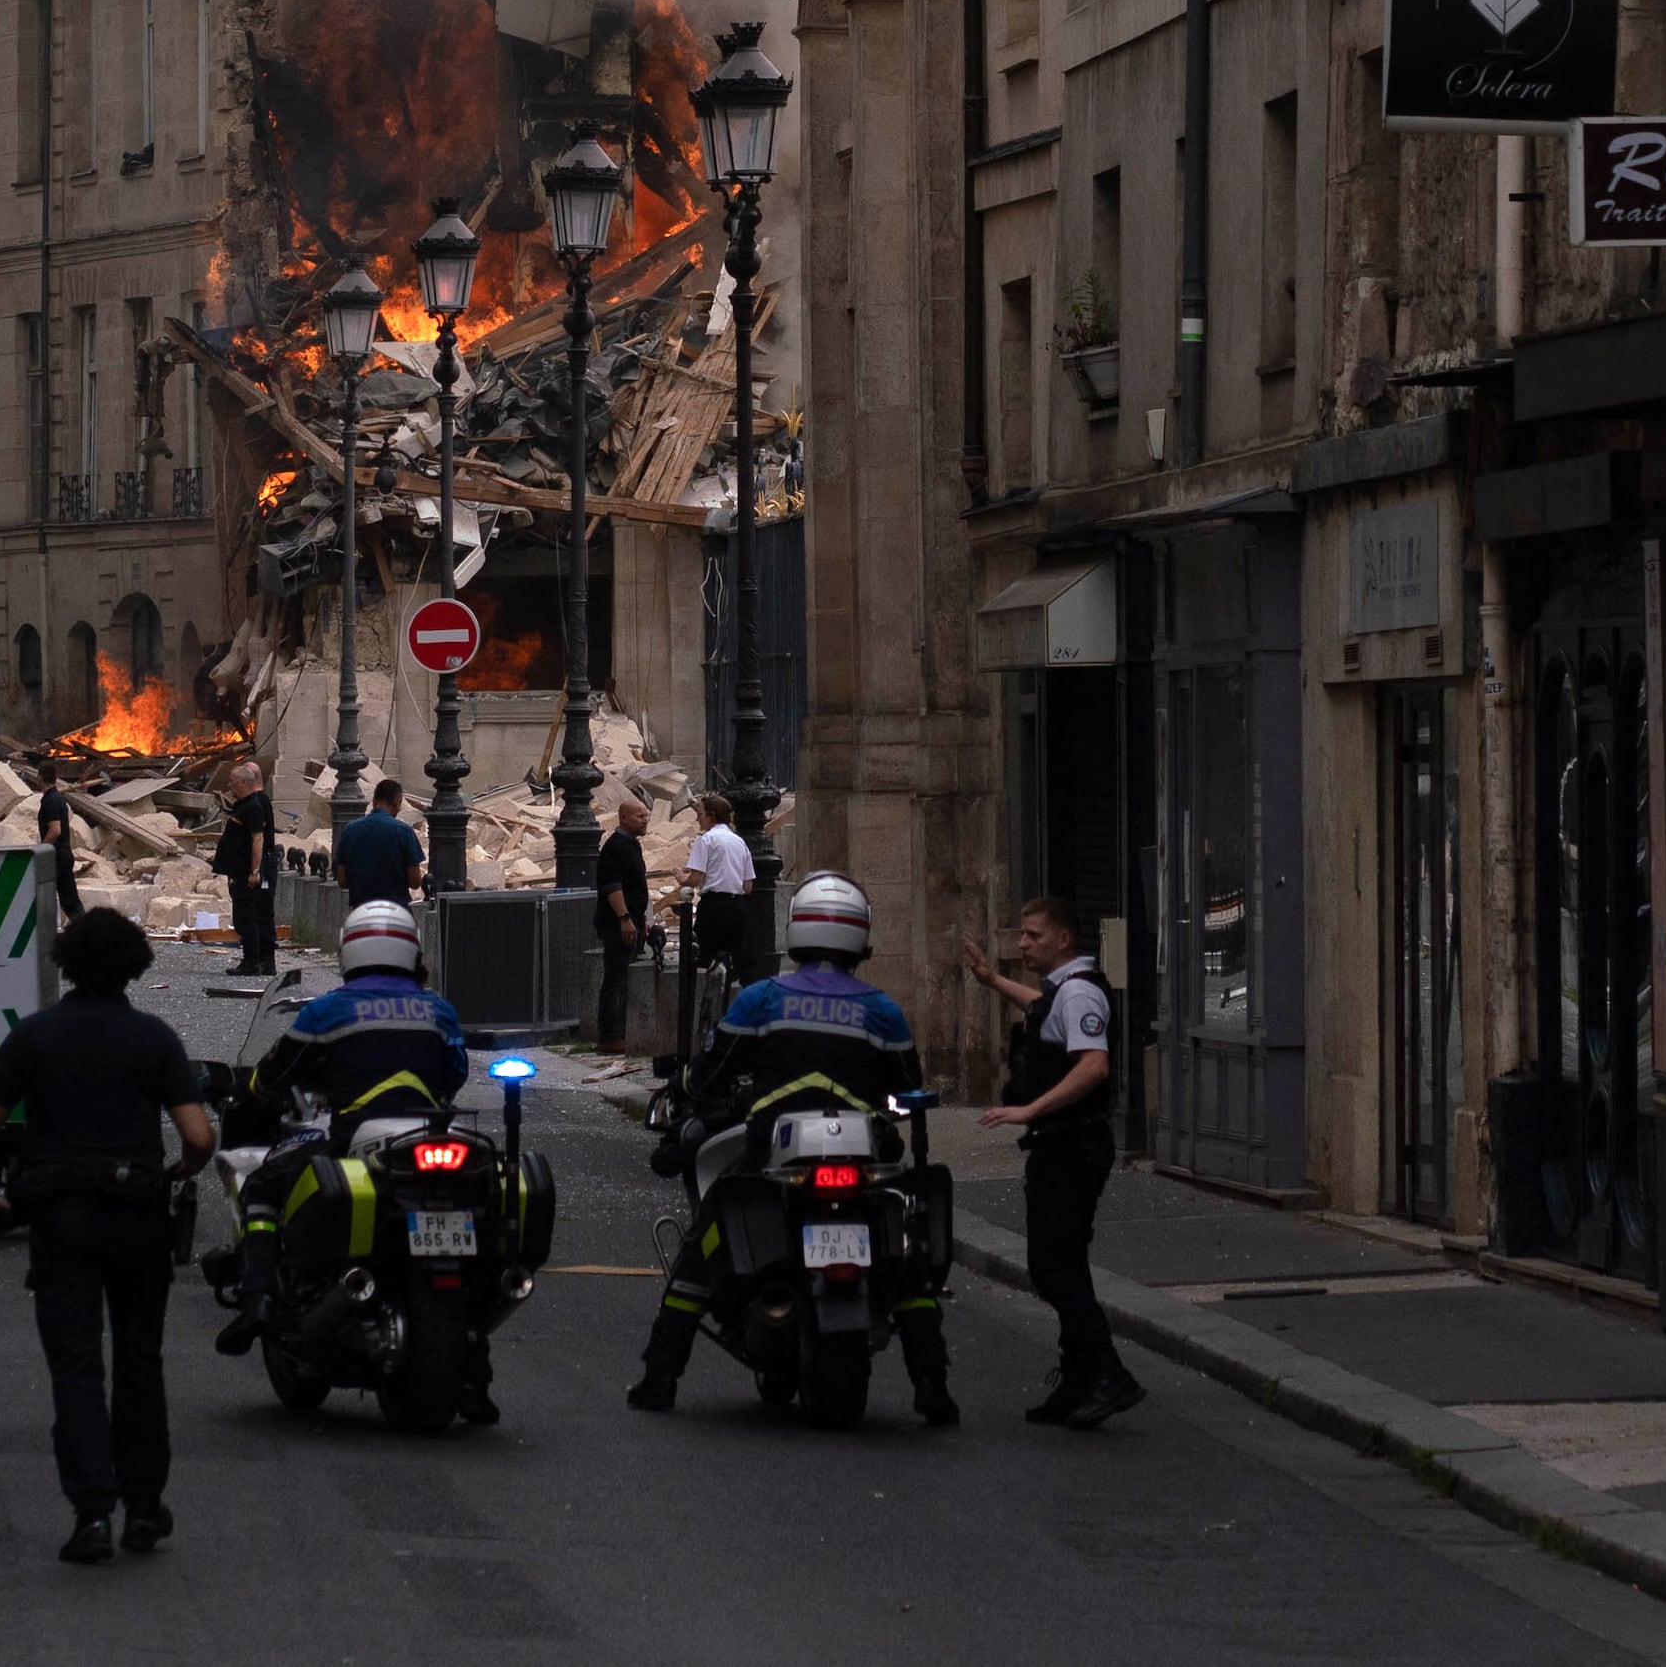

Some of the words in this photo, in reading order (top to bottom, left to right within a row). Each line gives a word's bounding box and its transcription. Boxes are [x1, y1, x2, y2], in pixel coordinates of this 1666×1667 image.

[1446, 61, 1554, 101] Solera
[355, 997, 436, 1022] POLICE
[783, 995, 867, 1027] POLICE
